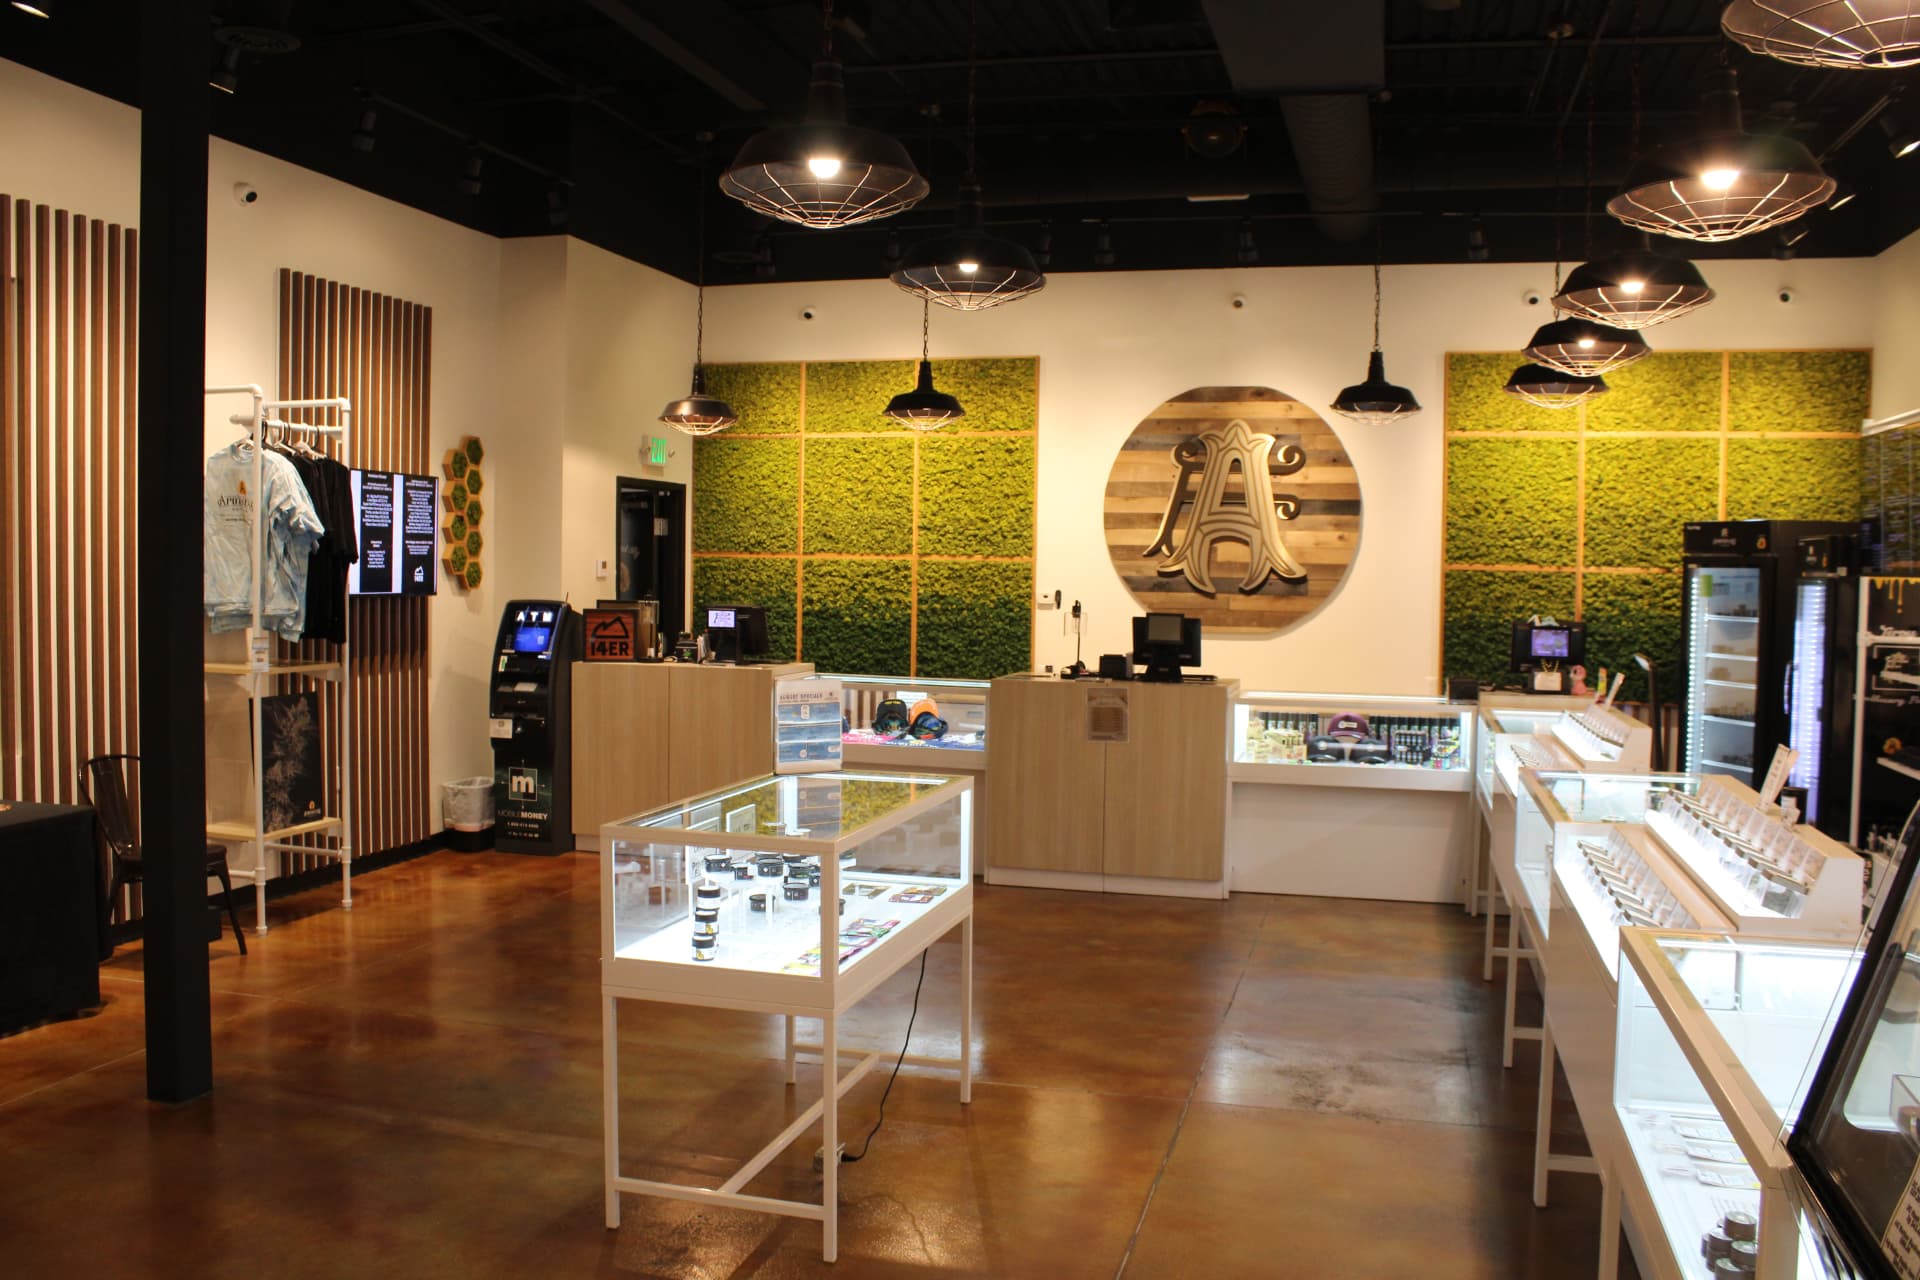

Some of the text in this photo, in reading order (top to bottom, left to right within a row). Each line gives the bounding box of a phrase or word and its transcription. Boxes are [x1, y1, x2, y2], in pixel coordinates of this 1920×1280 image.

[516, 611, 552, 622] ATM
[591, 641, 629, 656] 14ER
[511, 775, 535, 793] m
